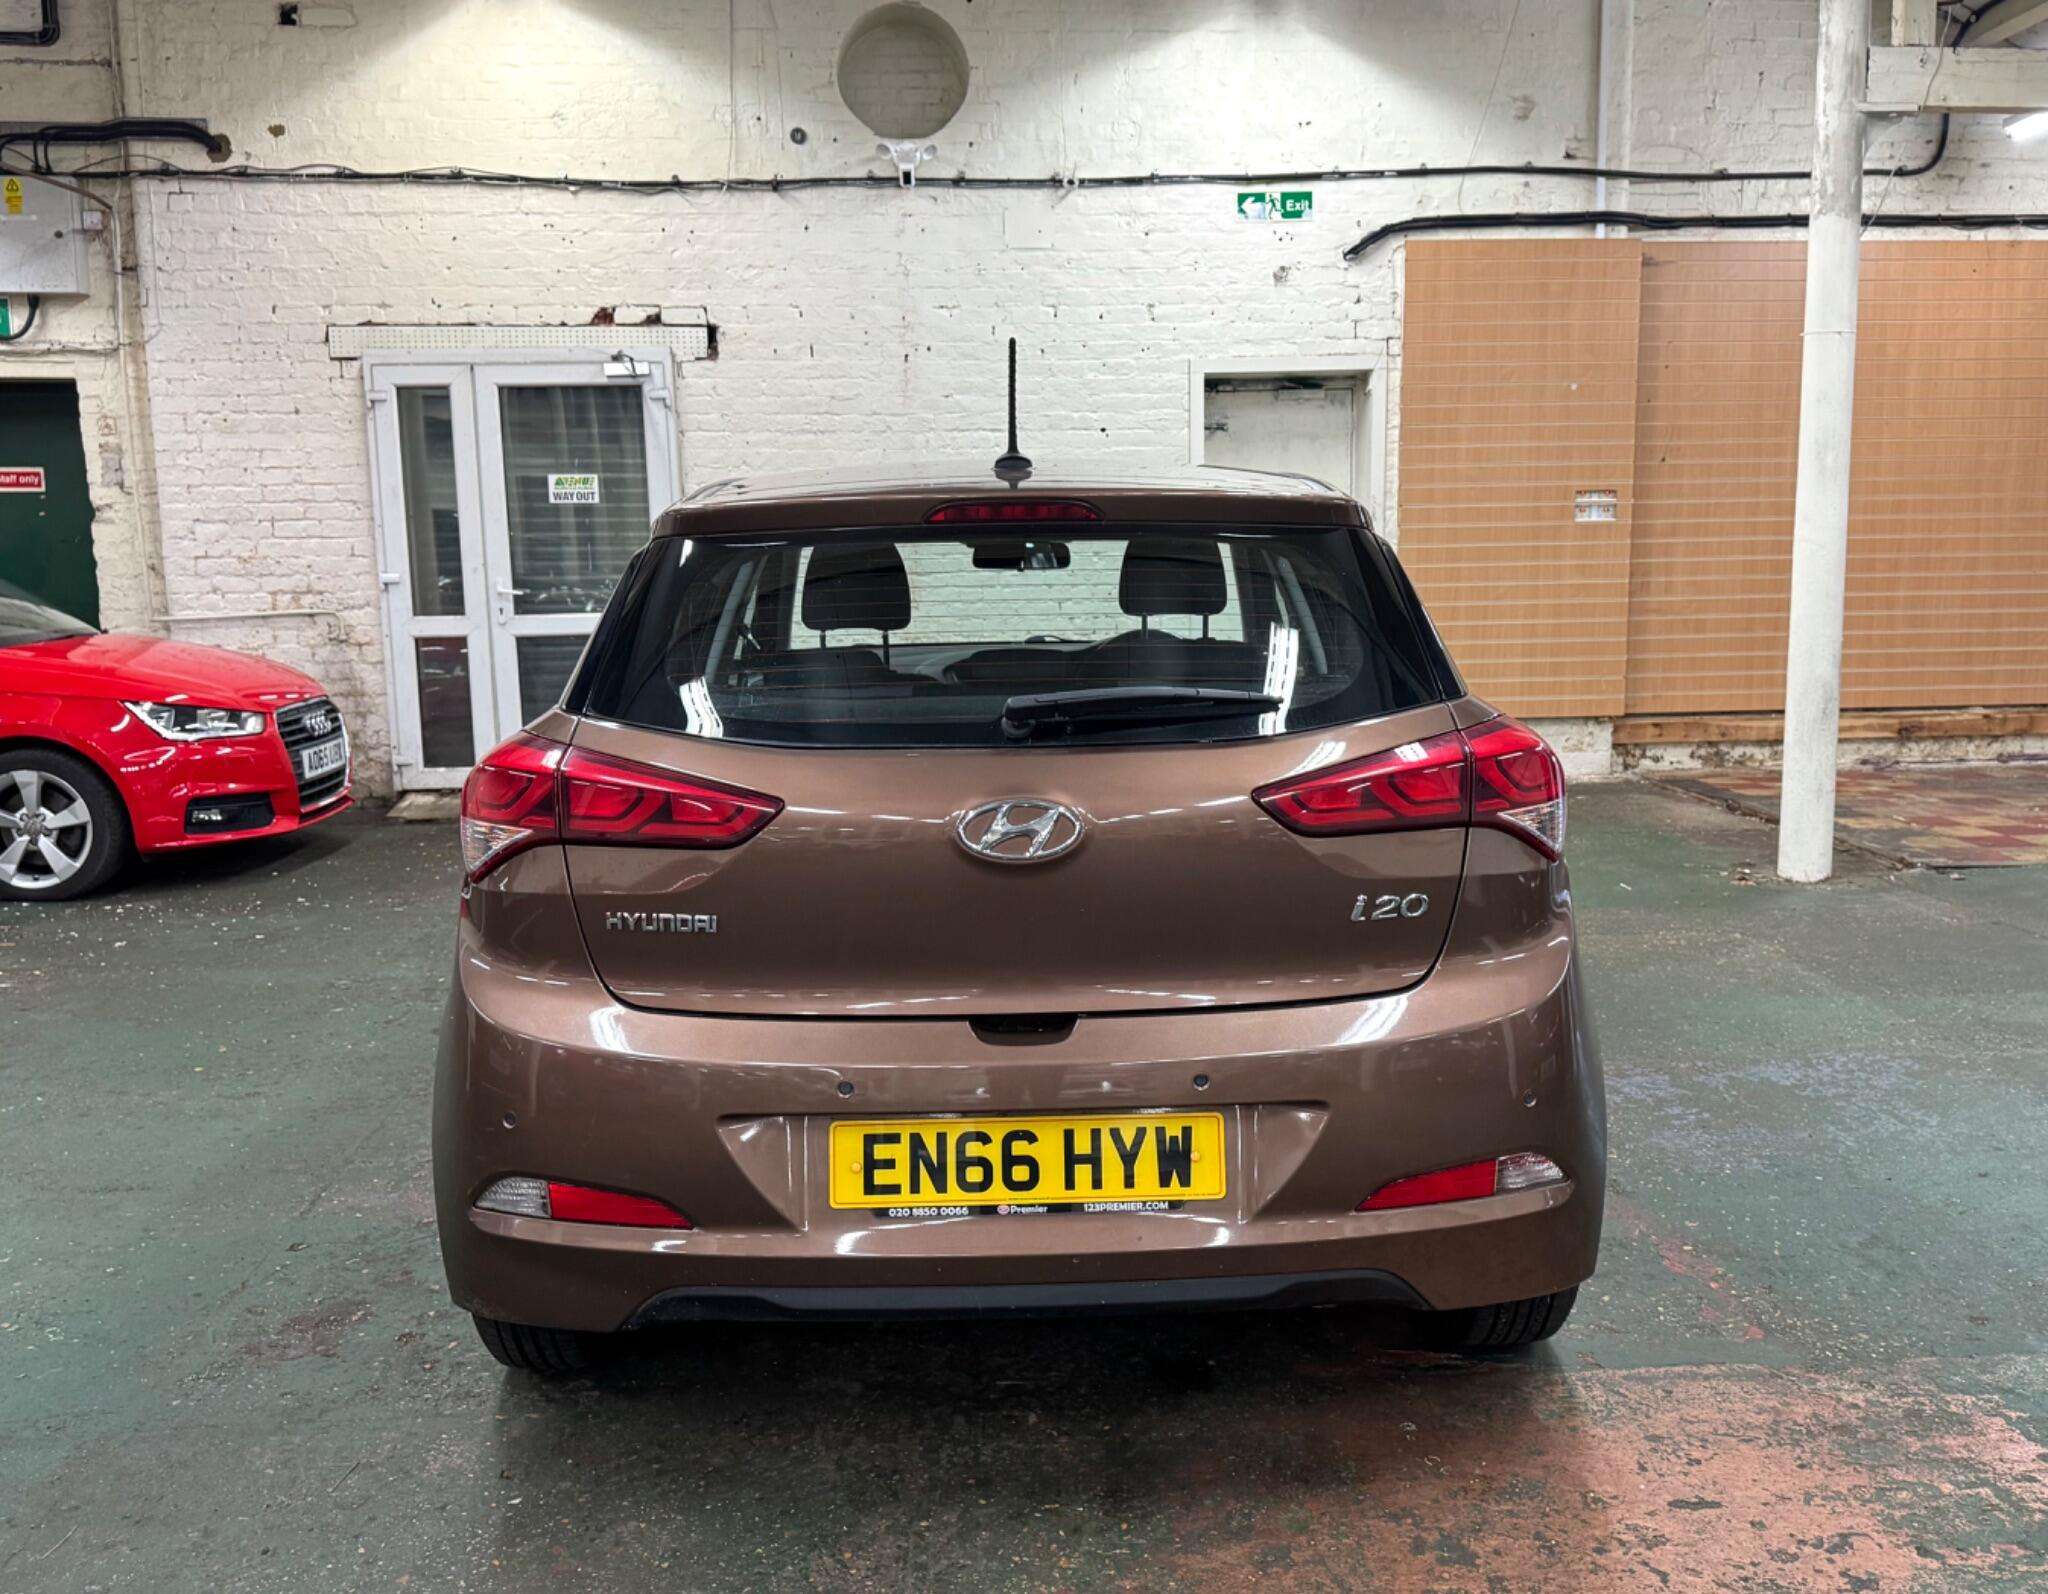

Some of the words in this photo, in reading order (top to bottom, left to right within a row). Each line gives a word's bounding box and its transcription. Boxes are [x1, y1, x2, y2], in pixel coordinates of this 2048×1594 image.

[1285, 199, 1309, 211] Exit
[20, 474, 39, 486] only
[553, 491, 574, 501] WAY
[576, 491, 595, 501] OUT
[605, 911, 717, 933] HYUNDAI
[863, 1129, 1040, 1195] EN66
[1063, 1126, 1192, 1191] HYW
[888, 1207, 910, 1217] 020
[940, 1206, 969, 1216] 0066
[1011, 1205, 1048, 1214] Premier
[1084, 1201, 1168, 1212] 123PREMIER.COM
